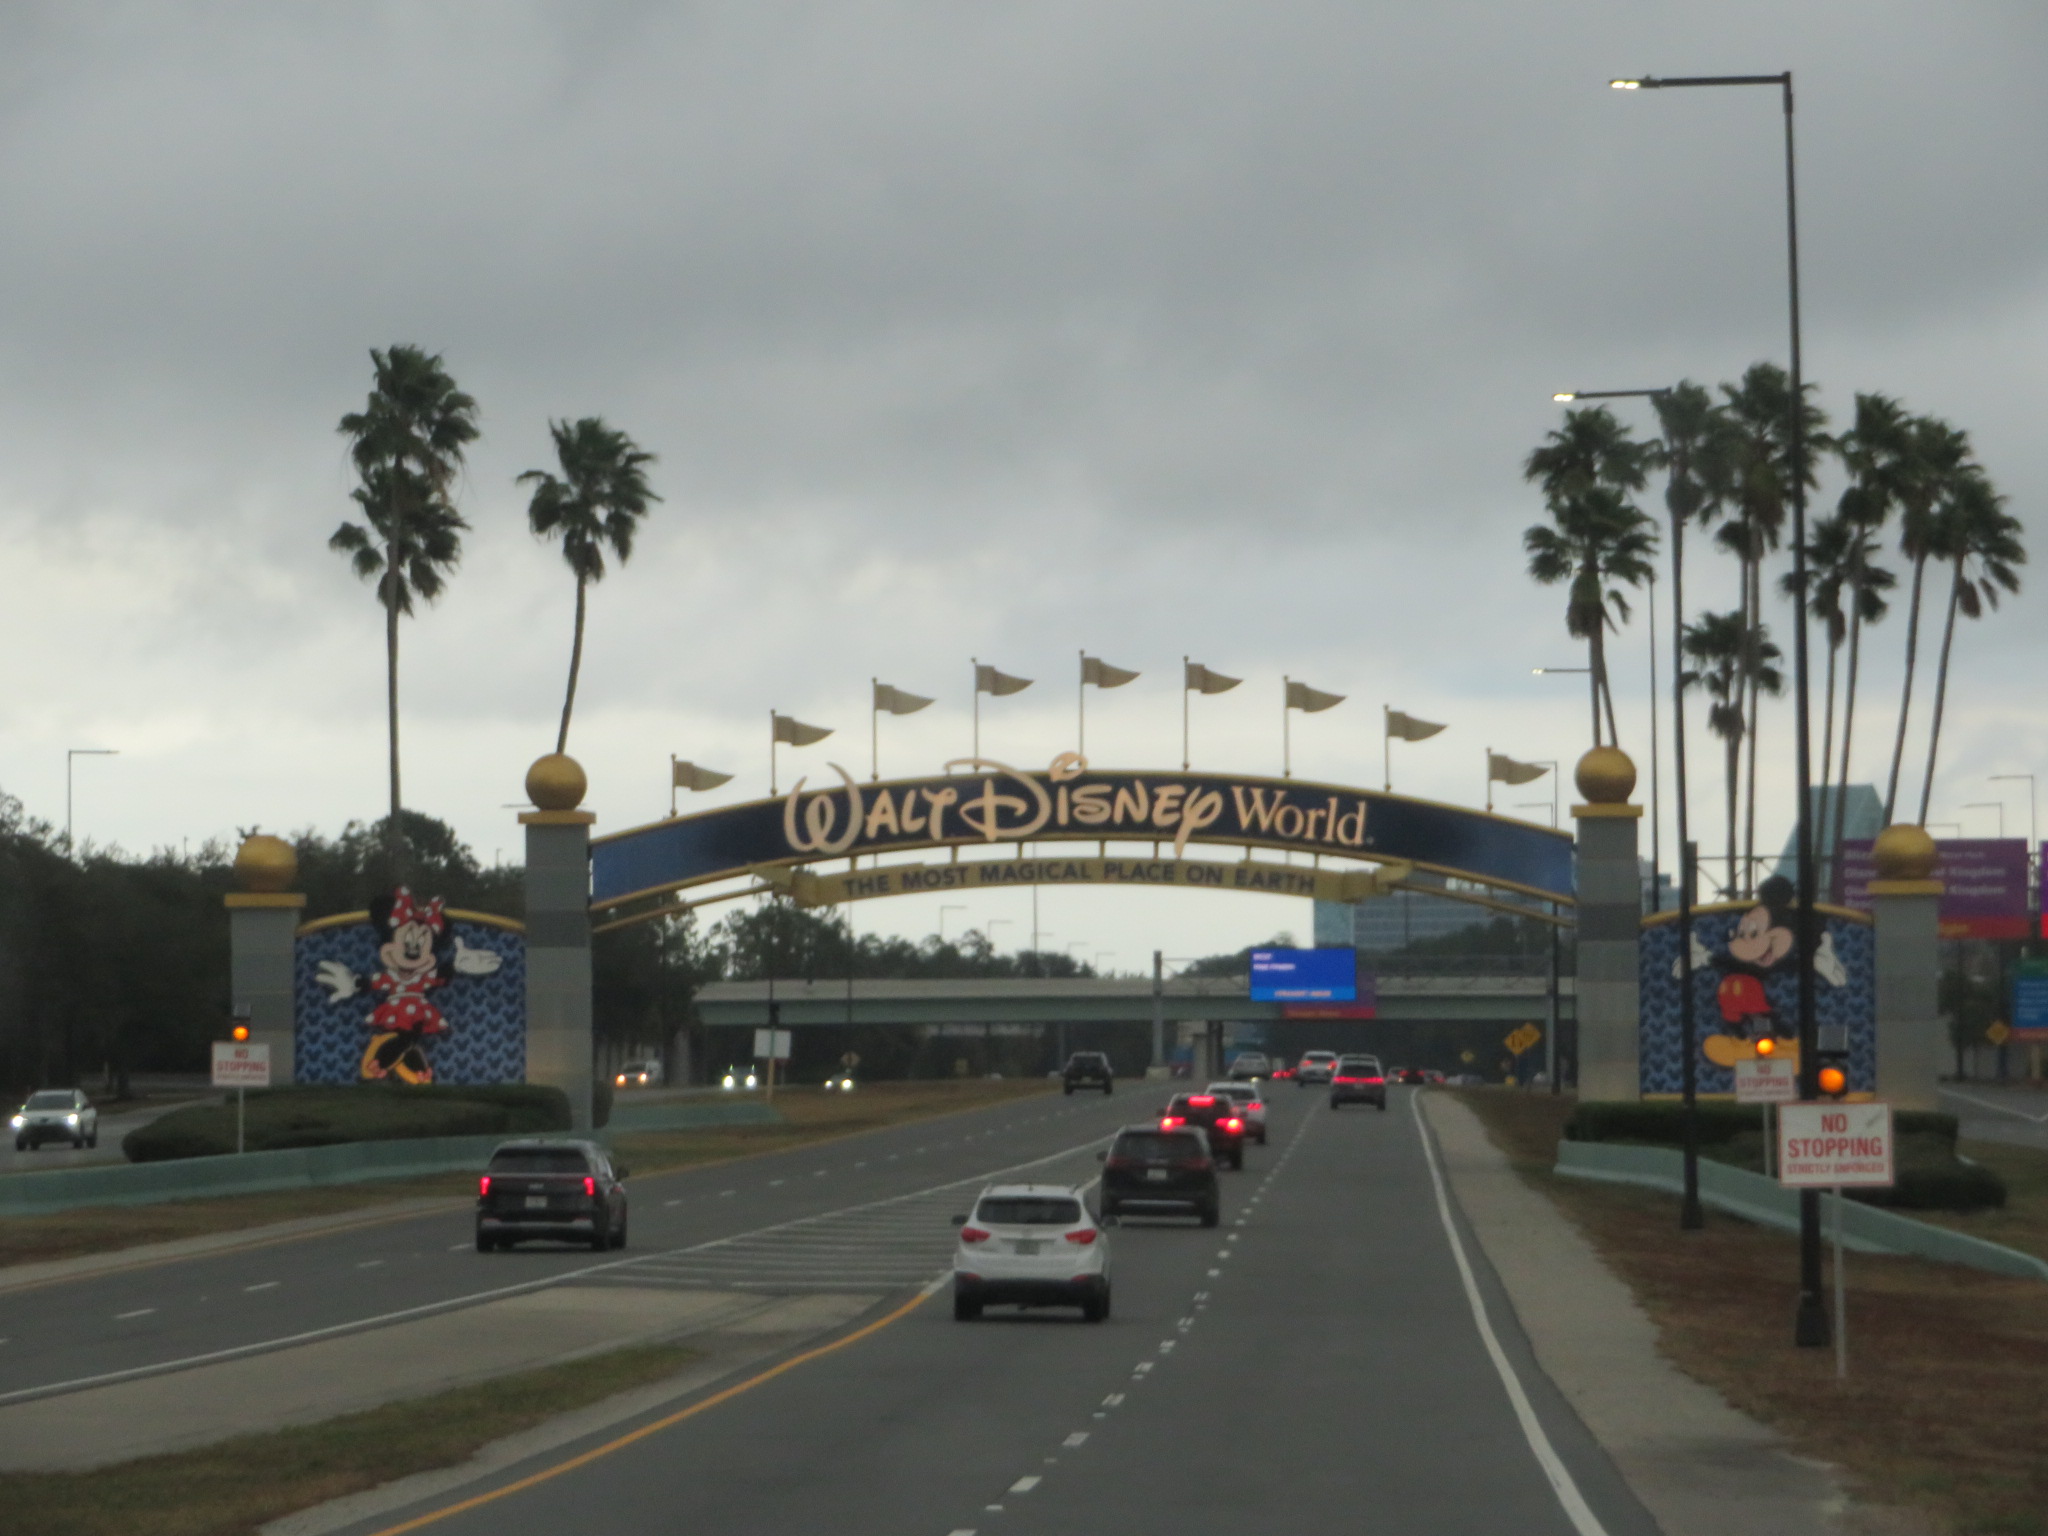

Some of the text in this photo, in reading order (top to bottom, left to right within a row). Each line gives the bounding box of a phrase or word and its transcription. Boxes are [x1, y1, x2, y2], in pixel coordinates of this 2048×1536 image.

[844, 862, 1316, 895] THE MOST MAGICAL PLACE ON EARTH
[1757, 1063, 1772, 1075] NO
[1738, 1077, 1790, 1088] STOPPING
[1821, 1113, 1848, 1134] NO
[1787, 1136, 1883, 1158] STOPPING
